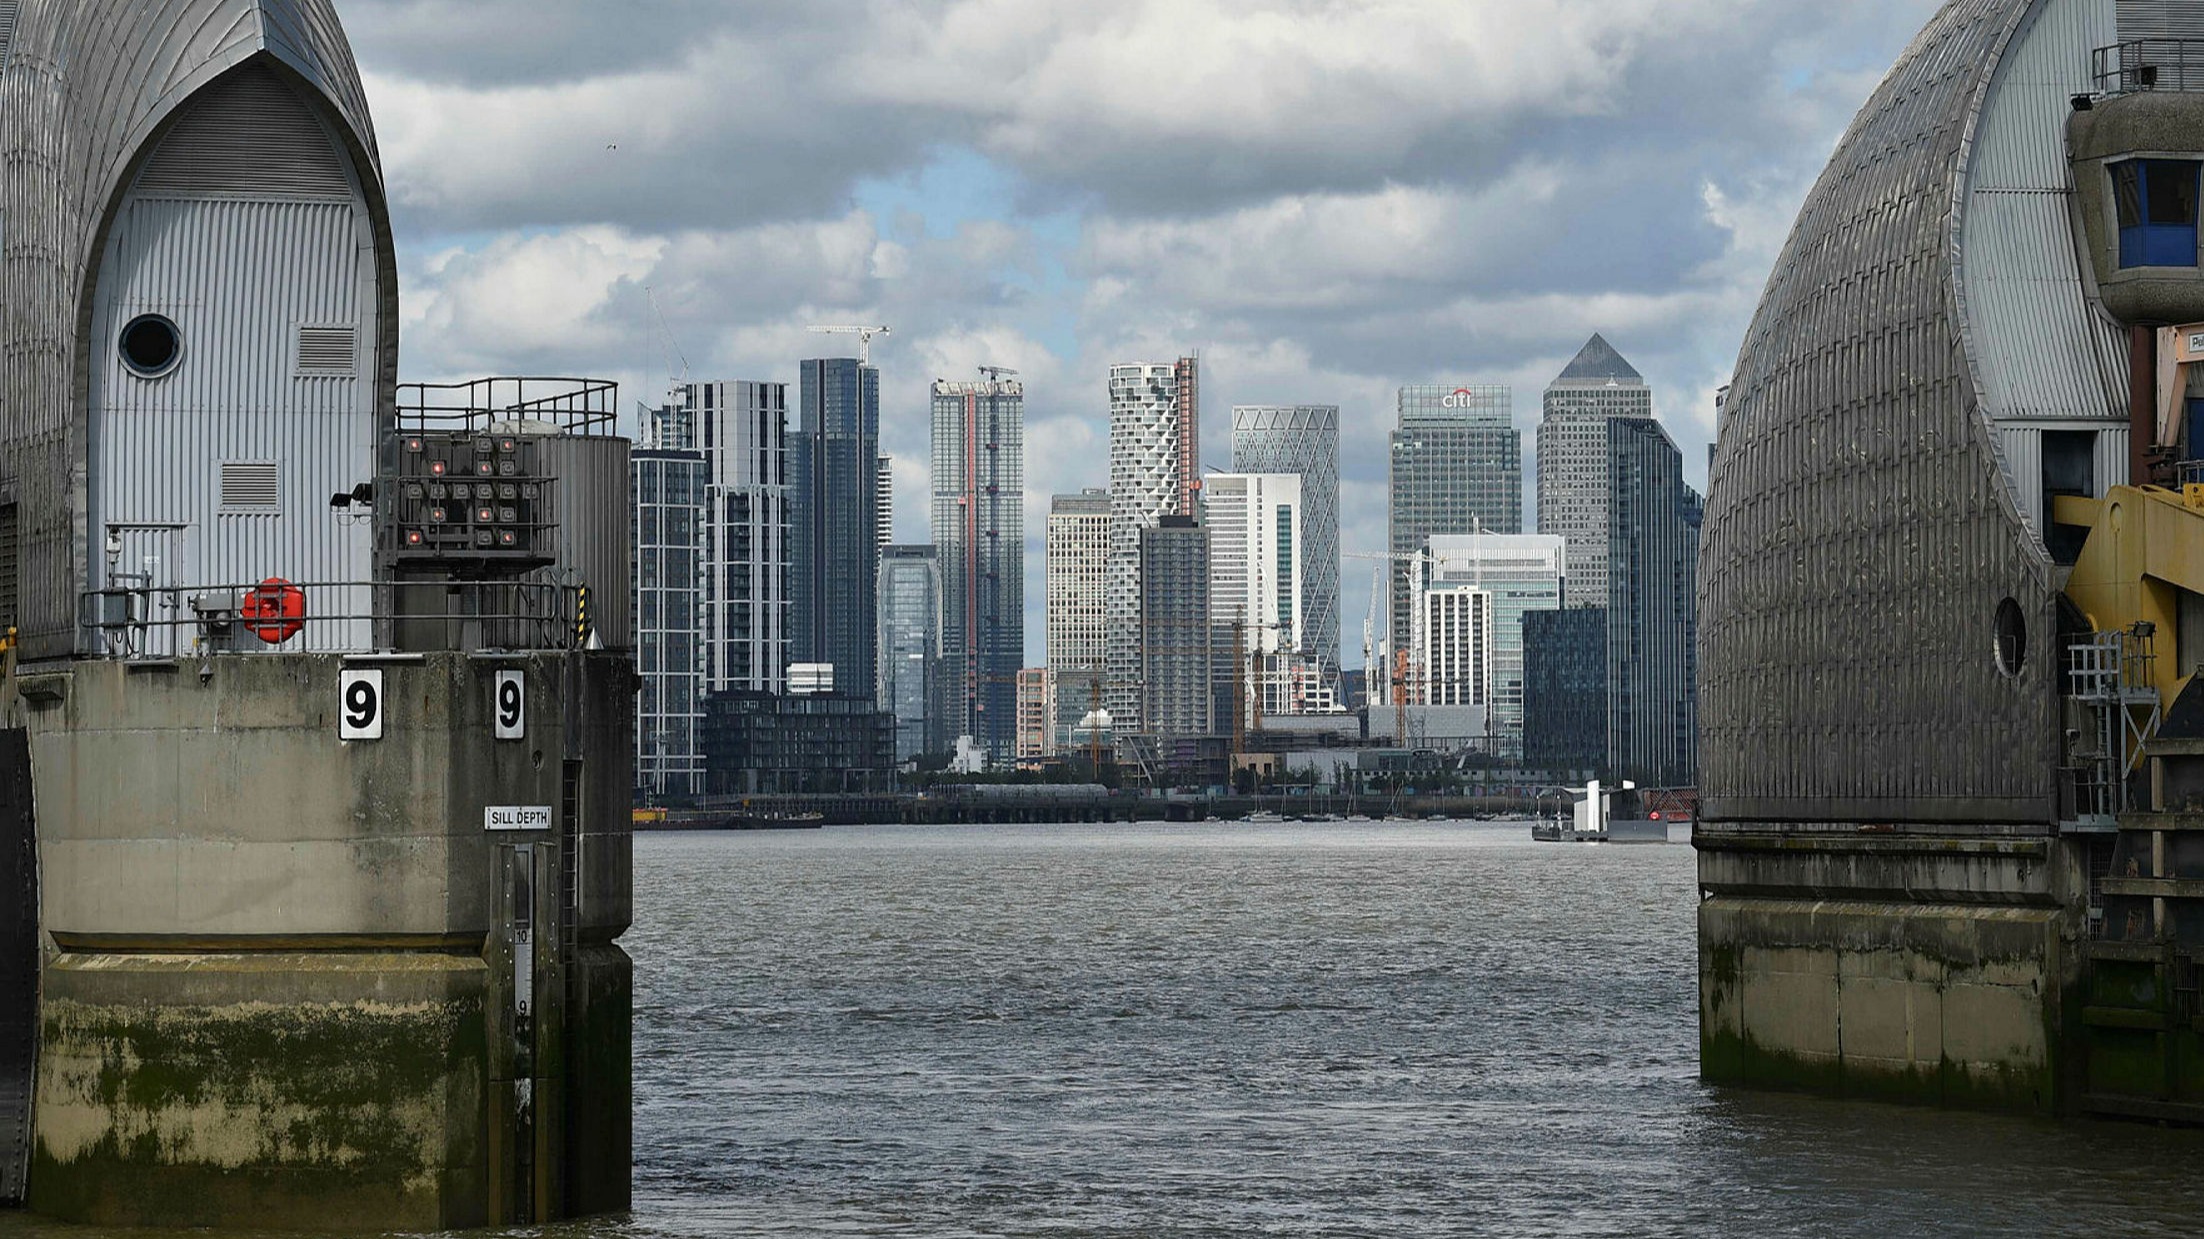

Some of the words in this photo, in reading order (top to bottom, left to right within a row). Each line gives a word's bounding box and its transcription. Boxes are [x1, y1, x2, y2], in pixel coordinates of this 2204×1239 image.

[1442, 389, 1471, 408] citi
[346, 680, 377, 729] 9
[499, 680, 521, 728] 9
[491, 811, 513, 825] SILL
[517, 811, 547, 825] DEPTH
[517, 930, 527, 942] 10
[519, 1000, 527, 1015] 9
